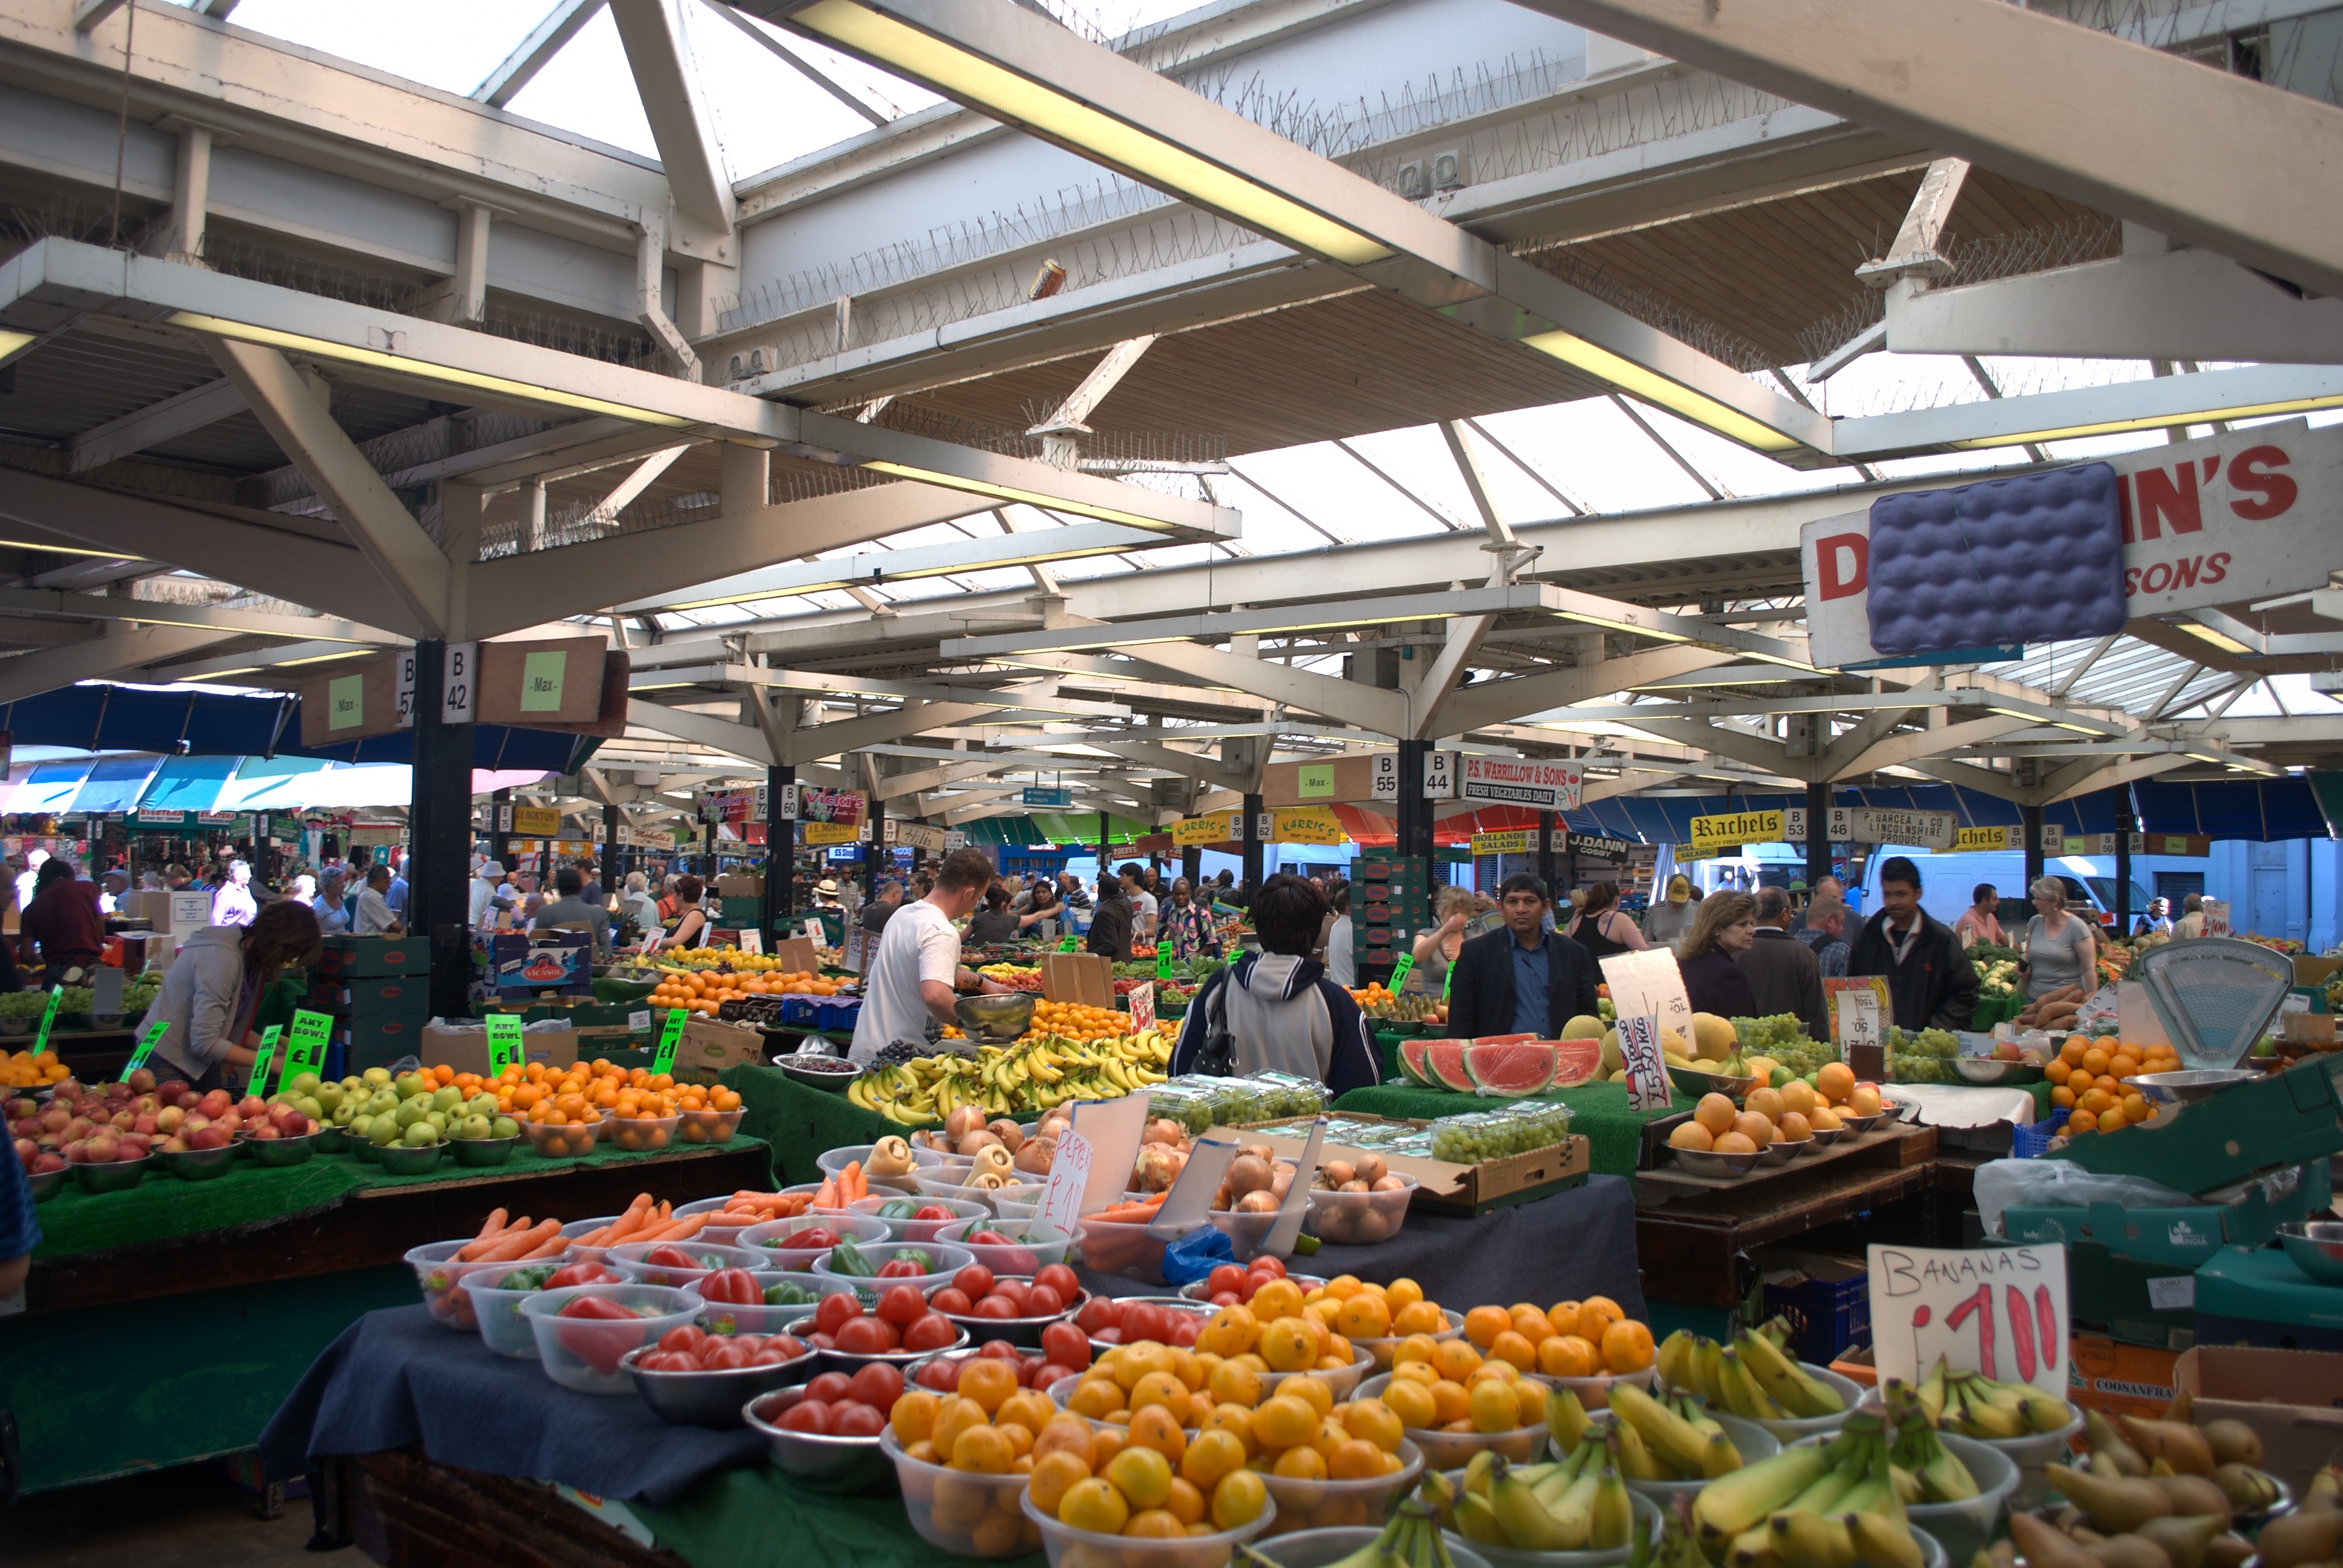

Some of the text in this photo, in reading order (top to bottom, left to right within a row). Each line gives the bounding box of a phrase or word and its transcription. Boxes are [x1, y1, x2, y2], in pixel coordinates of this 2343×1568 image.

[2125, 551, 2232, 599] SONS
[405, 658, 414, 682] B
[453, 652, 464, 676] B
[401, 690, 415, 714] 57
[447, 684, 467, 710] 42
[1381, 758, 1391, 773] B
[1433, 755, 1444, 770] B
[1467, 760, 1566, 787] P.S. WARRILLOW & SONS
[1377, 776, 1395, 791] 55
[1426, 775, 1448, 790] 44
[759, 789, 765, 799] B
[787, 788, 793, 798] B
[1468, 784, 1554, 802] FRESH VEGETABLES DAILY
[700, 793, 753, 808] Vicki's
[805, 792, 865, 809] Vicki's
[757, 804, 767, 814] 72
[784, 803, 795, 813] 60
[1235, 817, 1240, 825] B
[1262, 816, 1268, 825] B
[1792, 811, 1800, 822] B
[1834, 811, 1843, 821] B
[1930, 817, 1943, 827] CO
[1259, 827, 1270, 836] 62
[1695, 813, 1778, 837] Rachels
[1788, 825, 1804, 835] 53
[1830, 825, 1847, 835] 46
[1869, 822, 1941, 837] LINCOLNSHIRE
[1232, 828, 1243, 837] 70
[1473, 832, 1526, 842] HOLLANDS
[1880, 833, 1922, 845] PRODUCE
[1480, 840, 1519, 850] SALADS
[2011, 837, 2022, 846] 51
[1580, 847, 1612, 858] COSBY
[1681, 849, 1709, 858] SALADS
[298, 1017, 324, 1027] ANY
[294, 1026, 326, 1040] BOWL
[259, 1042, 275, 1051] BOWL
[659, 1039, 677, 1059] £1
[291, 1044, 324, 1067] £1
[495, 1044, 520, 1065] £1
[252, 1054, 271, 1080] £1
[2184, 1237, 2208, 1245] INDIA
[1881, 1248, 2041, 1297] BANANAS
[2095, 1379, 2173, 1401] COOSANFRA
